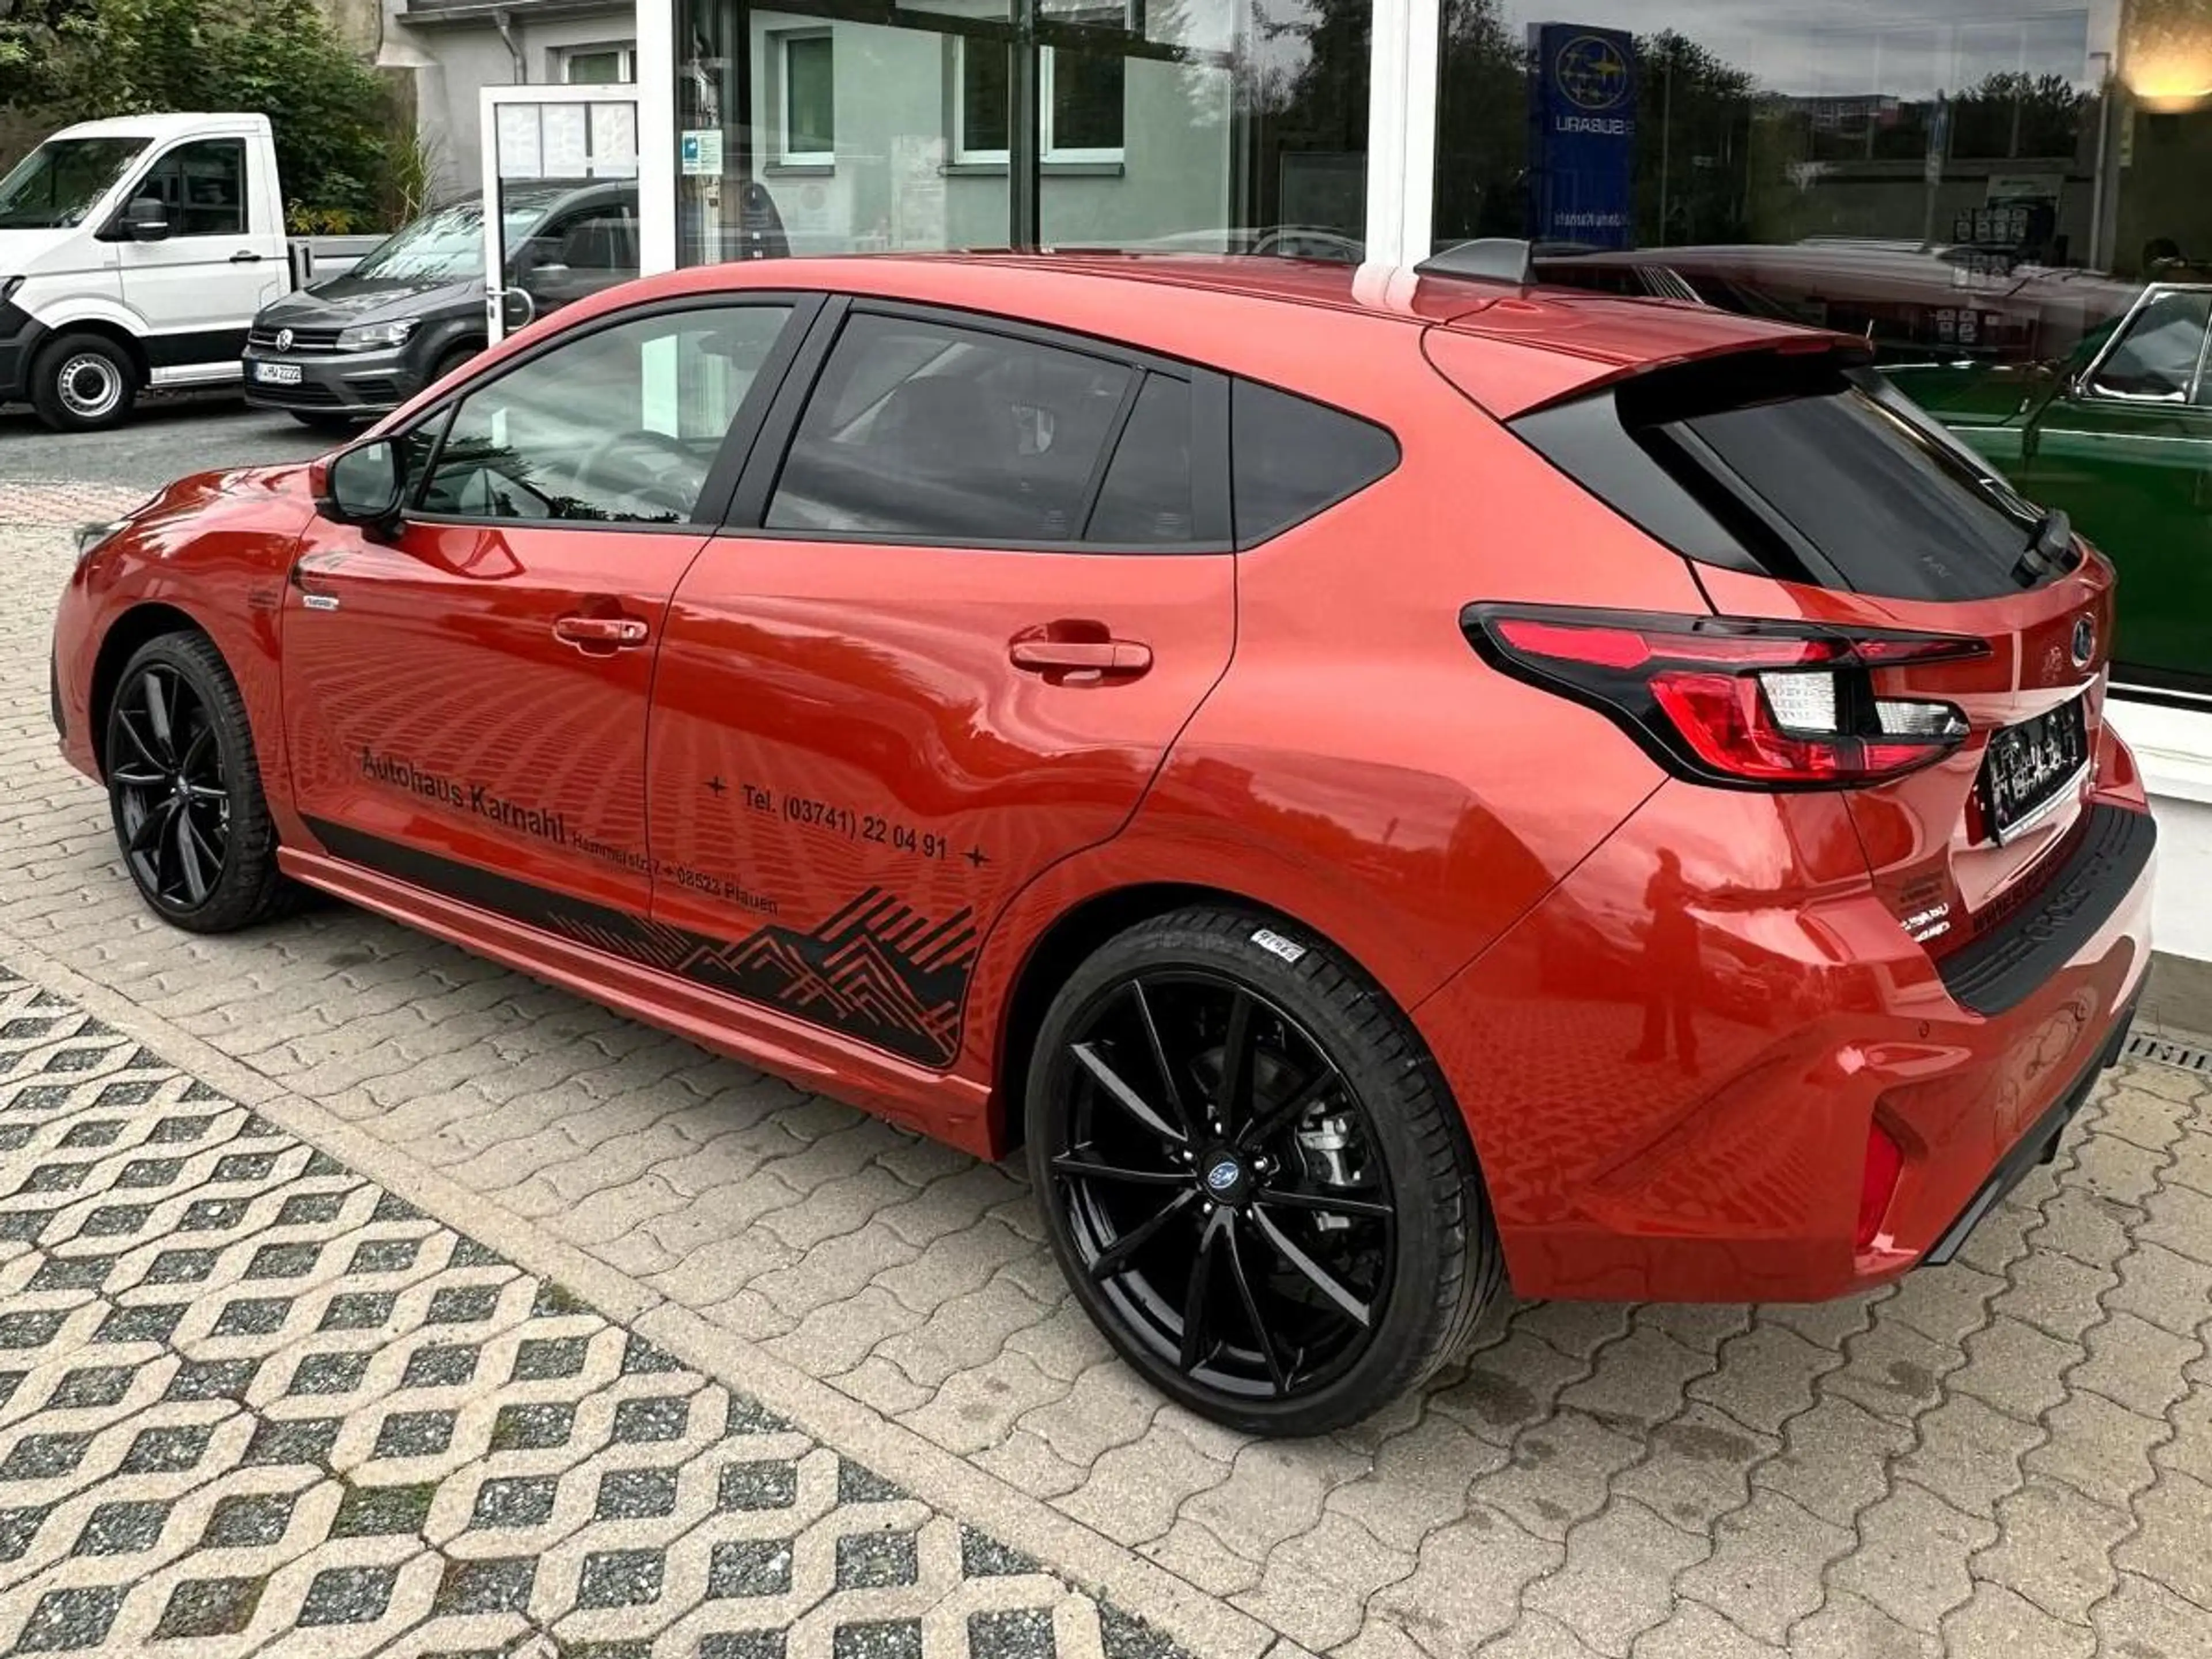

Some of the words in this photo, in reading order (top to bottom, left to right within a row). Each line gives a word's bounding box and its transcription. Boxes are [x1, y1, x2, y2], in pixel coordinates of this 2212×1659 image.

[362, 746, 463, 807] Autohaus
[469, 783, 566, 844] Karnahl
[744, 784, 777, 813] Tel.
[783, 797, 857, 840] (03741)
[862, 816, 887, 843] 22
[893, 825, 916, 852] 04
[923, 834, 947, 860] 91
[725, 882, 778, 916] Plauen
